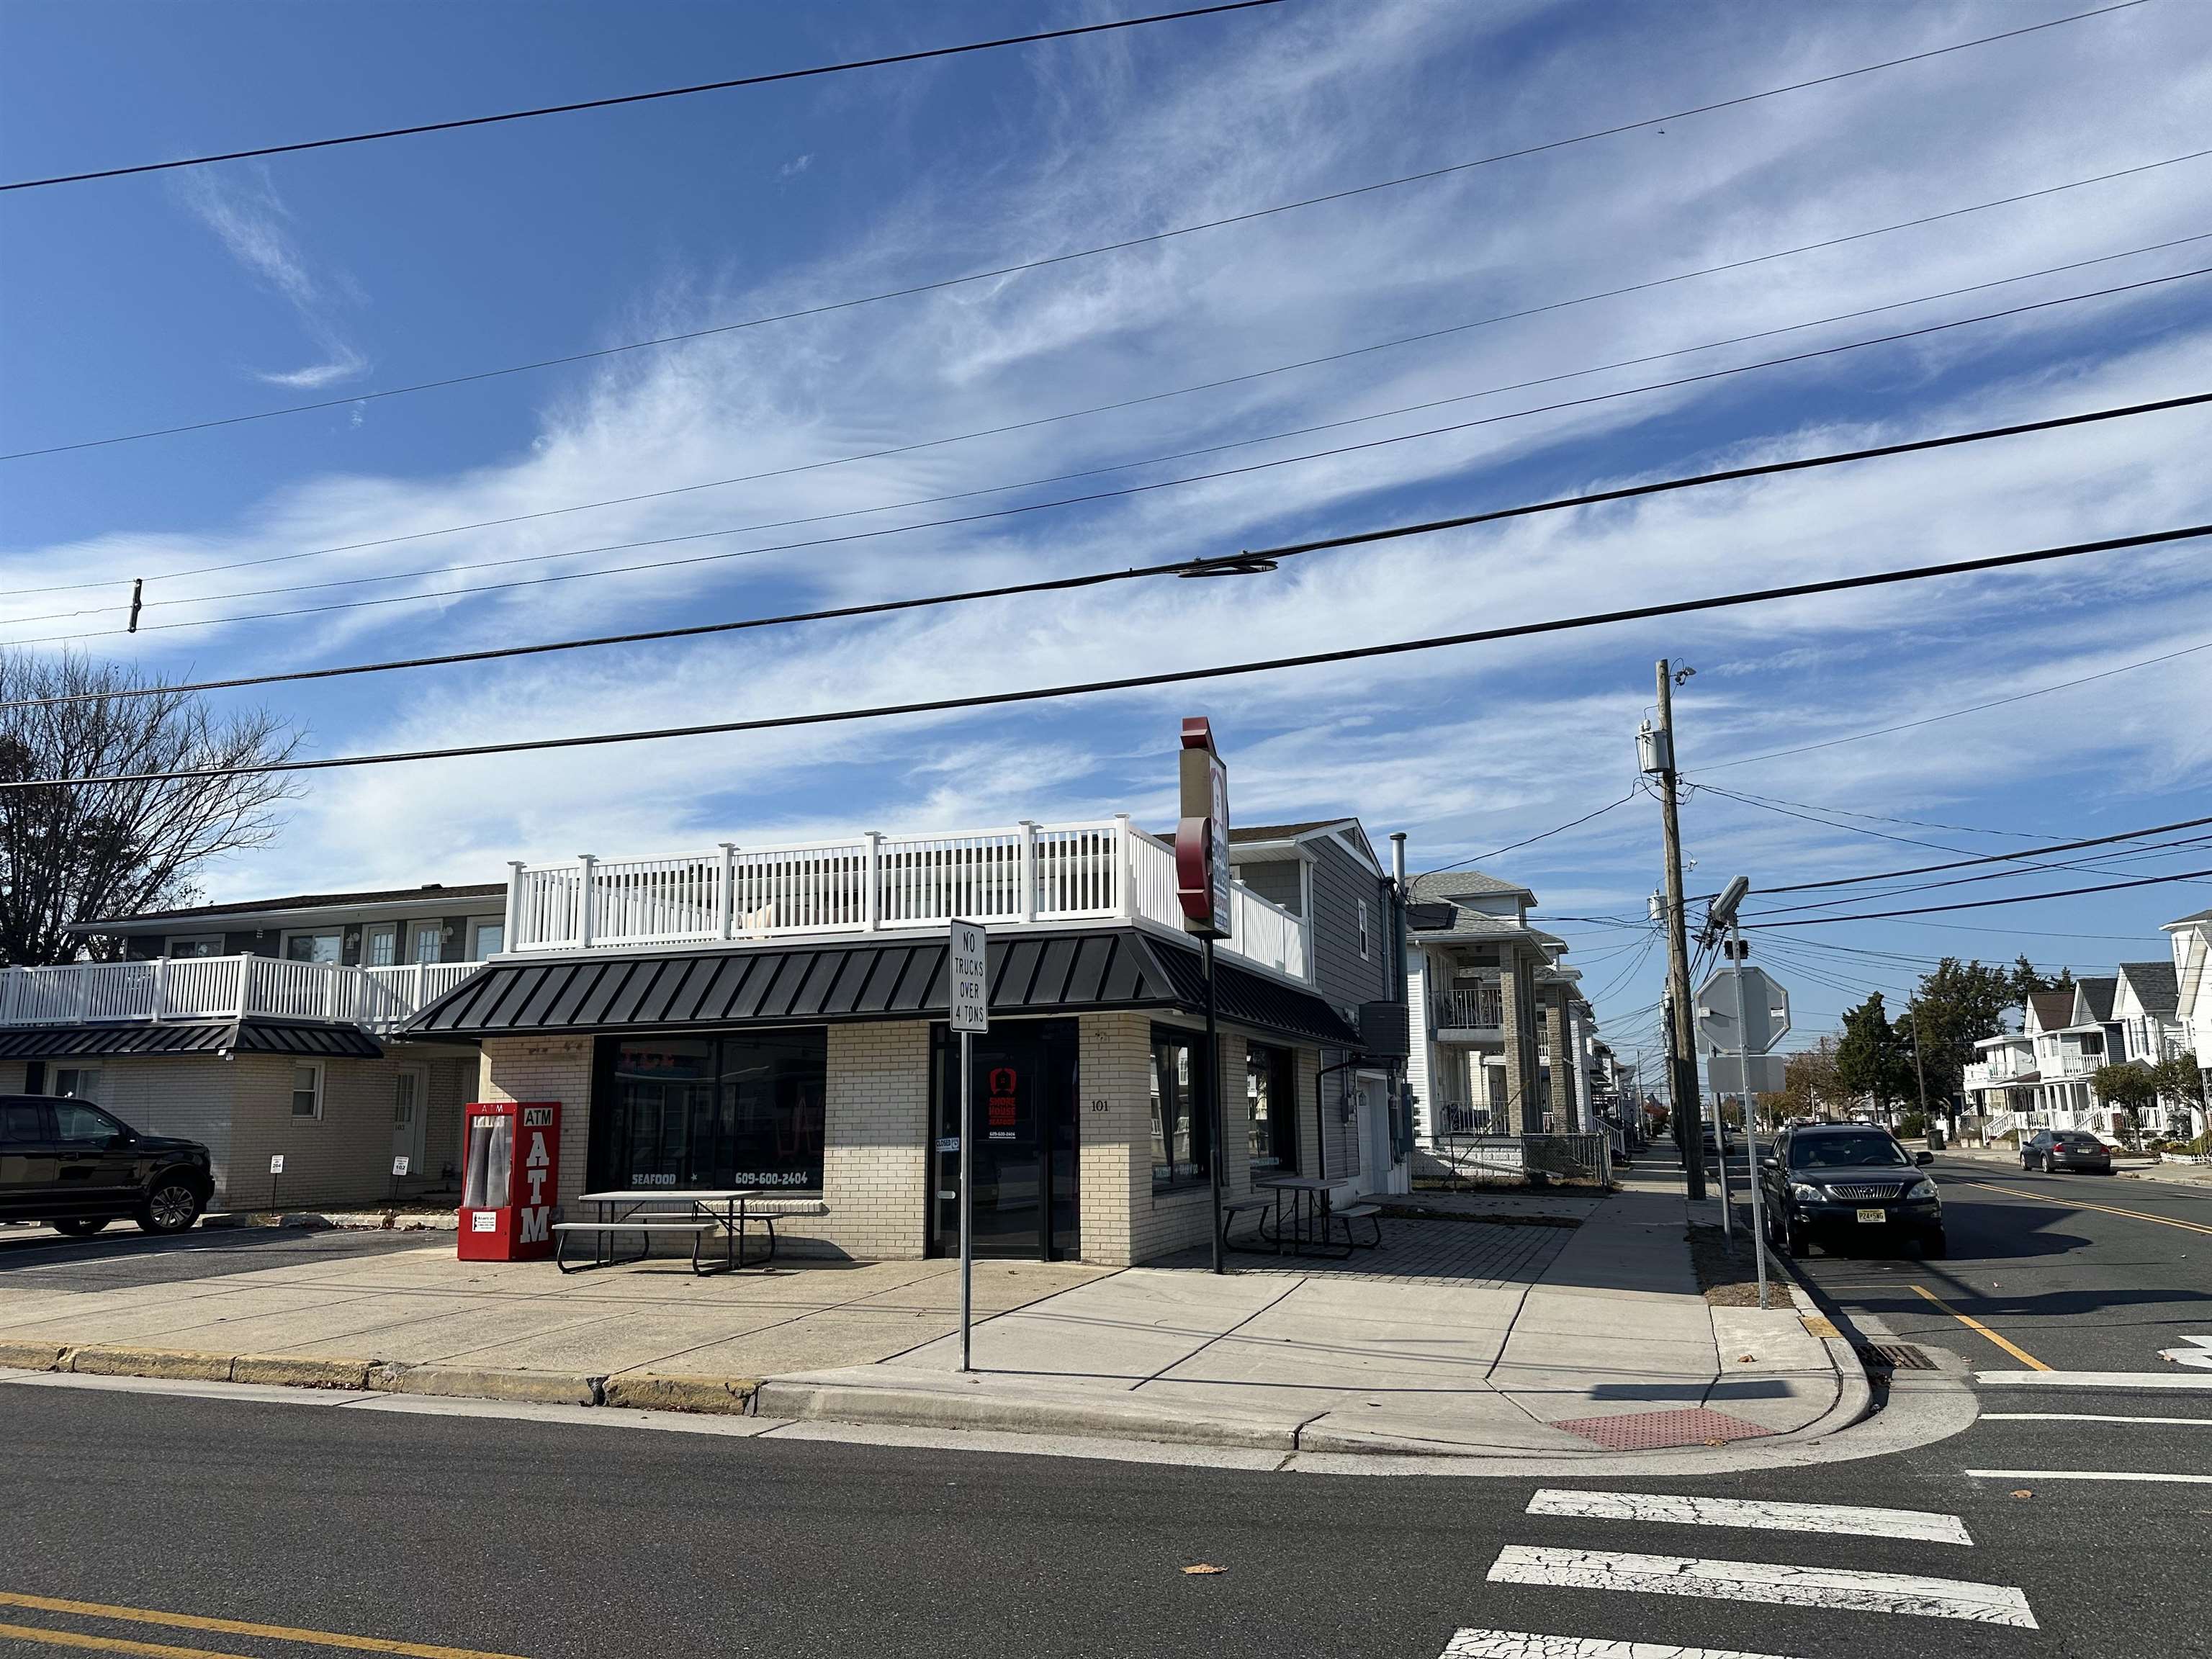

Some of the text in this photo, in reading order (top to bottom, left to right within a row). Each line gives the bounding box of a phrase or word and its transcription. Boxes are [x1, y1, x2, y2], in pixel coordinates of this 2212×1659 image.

[963, 931, 975, 953] NO
[955, 958, 983, 976] TRUCKS
[960, 981, 979, 999] OVER
[956, 1004, 984, 1022] 4 TONS
[1092, 1100, 1108, 1112] 101
[526, 1110, 551, 1125] ATM
[632, 1173, 676, 1185] SEAFOOD
[735, 1171, 808, 1185] 609-600-2404
